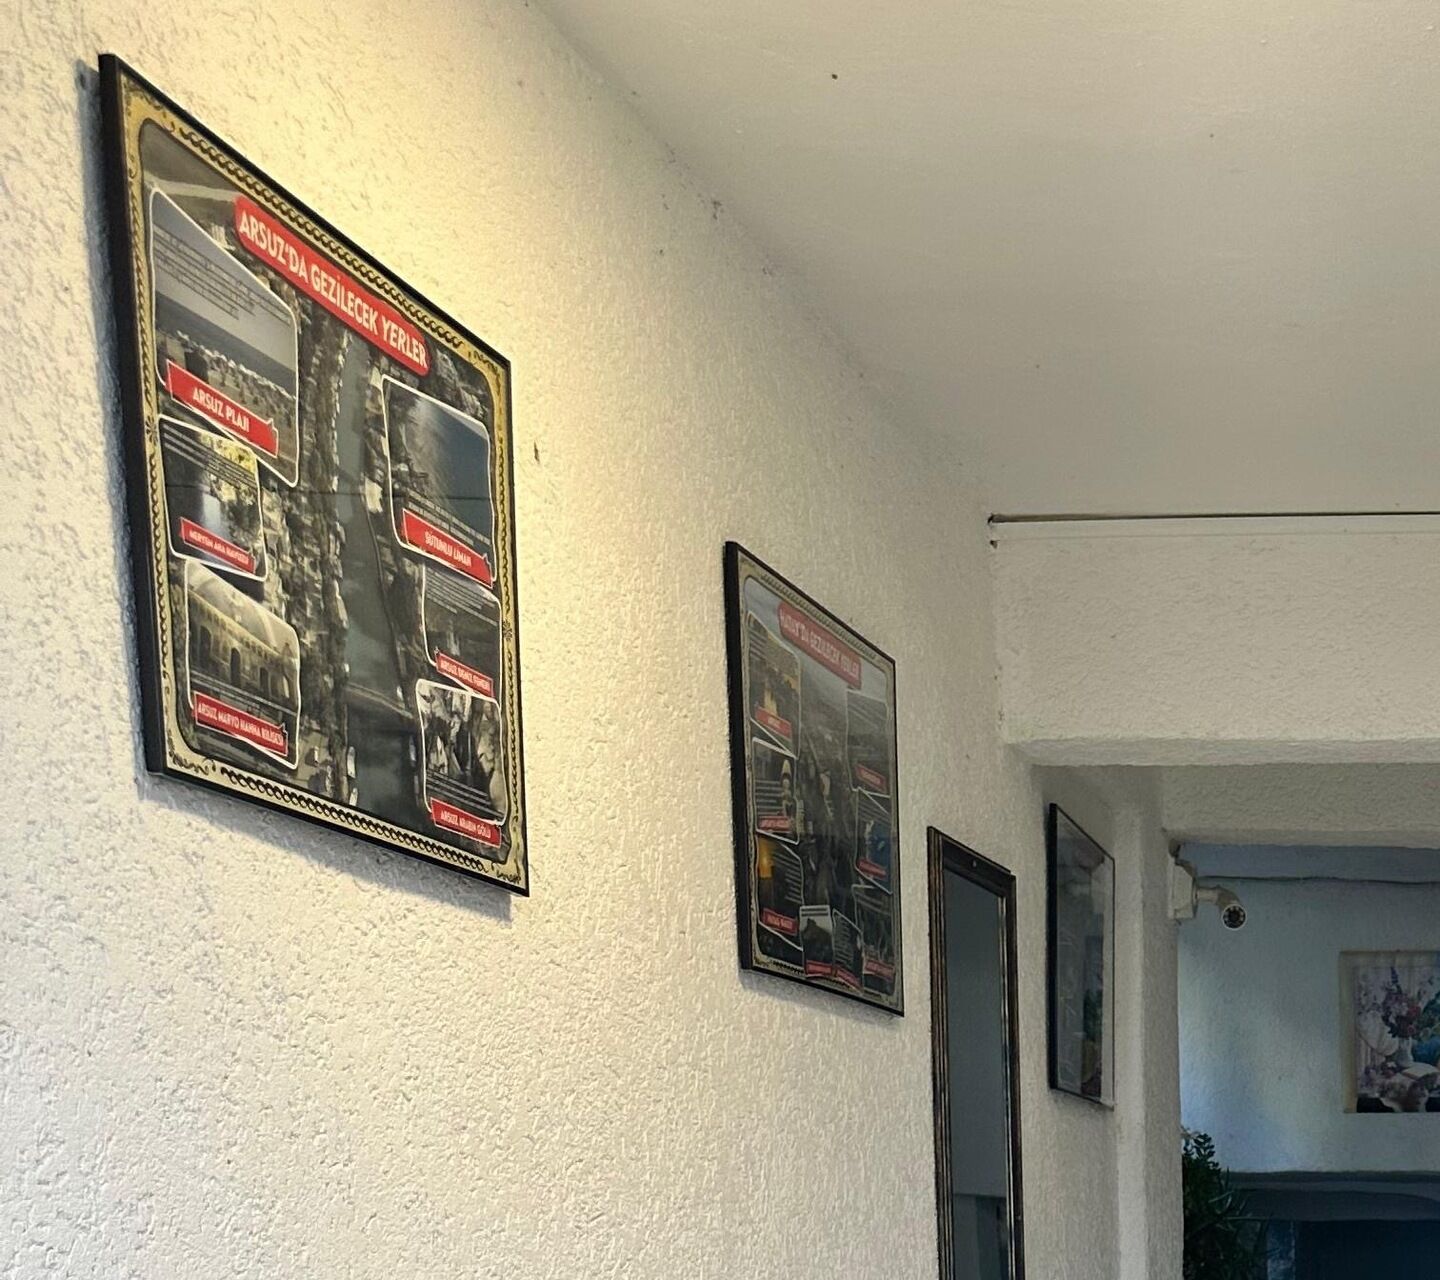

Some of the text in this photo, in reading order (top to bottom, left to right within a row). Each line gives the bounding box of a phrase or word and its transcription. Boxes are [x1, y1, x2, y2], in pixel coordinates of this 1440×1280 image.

[238, 210, 309, 284] ARSUZ'DA
[310, 264, 379, 336] GEZİLECEK
[381, 315, 428, 369] YERLER
[193, 387, 224, 418] ARSUZ
